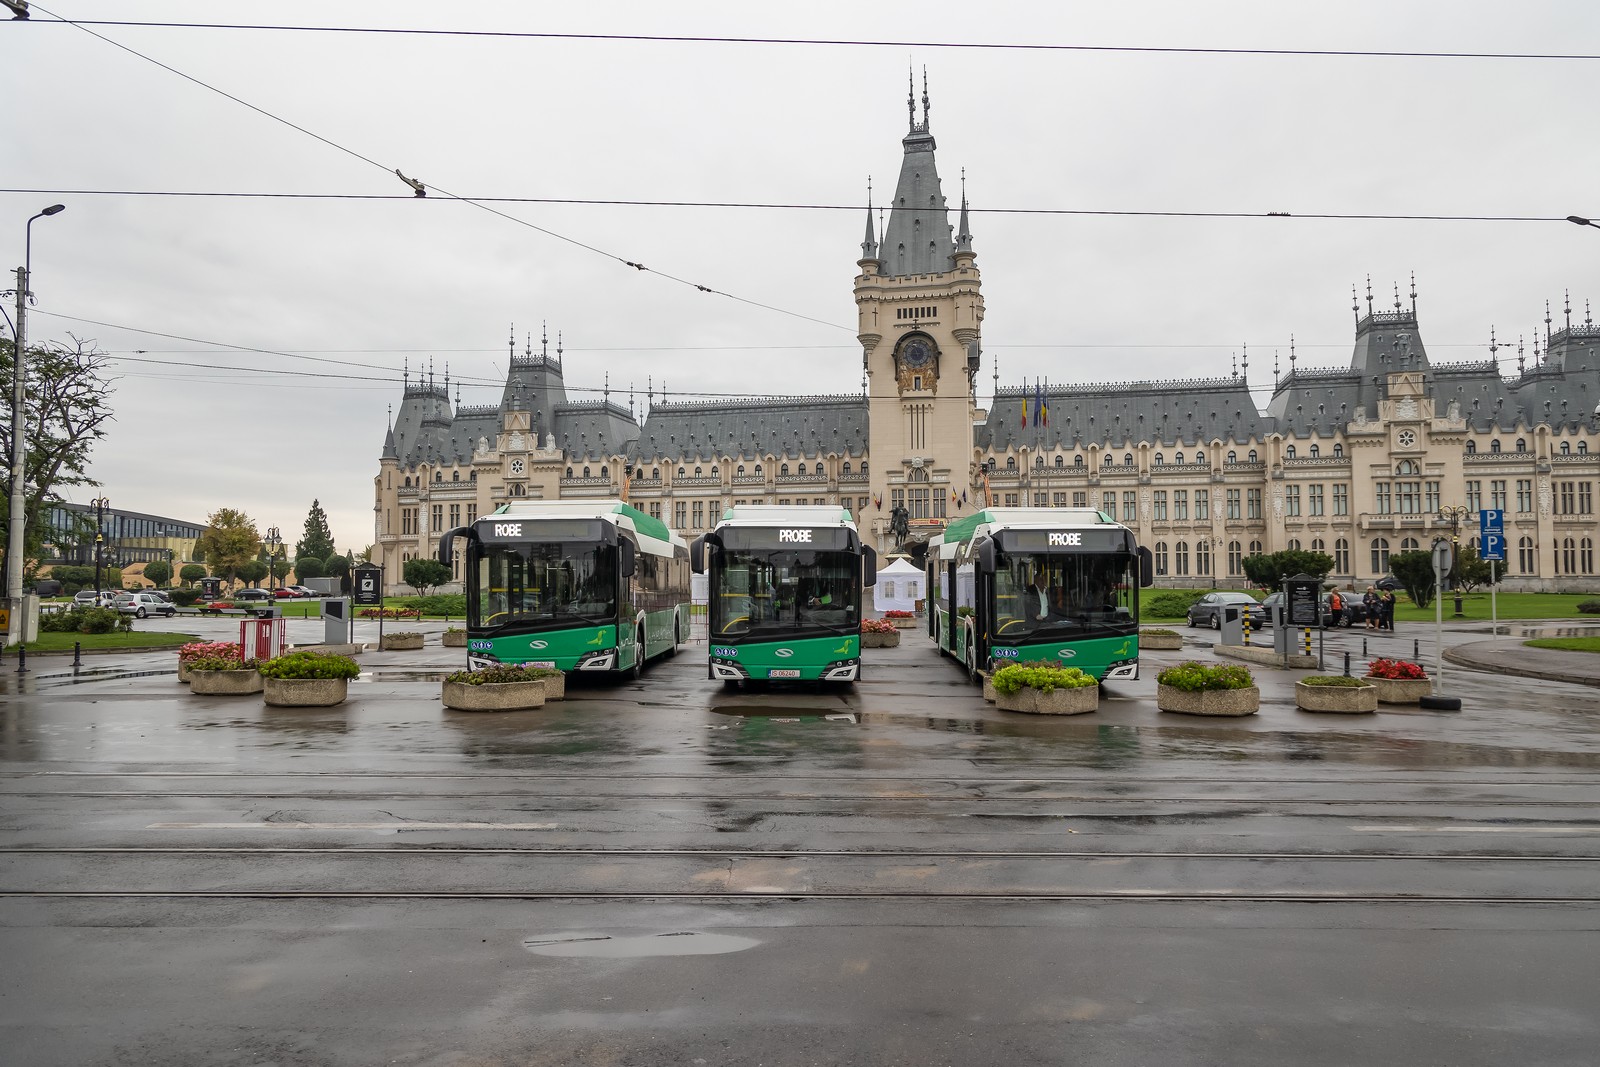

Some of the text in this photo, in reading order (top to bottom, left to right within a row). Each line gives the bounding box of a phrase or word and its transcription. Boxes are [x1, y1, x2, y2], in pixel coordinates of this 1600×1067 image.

[1486, 510, 1497, 527] P
[494, 523, 522, 537] ROBE
[779, 529, 812, 543] PROBE
[1048, 532, 1081, 546] PROBE
[1487, 535, 1498, 552] P
